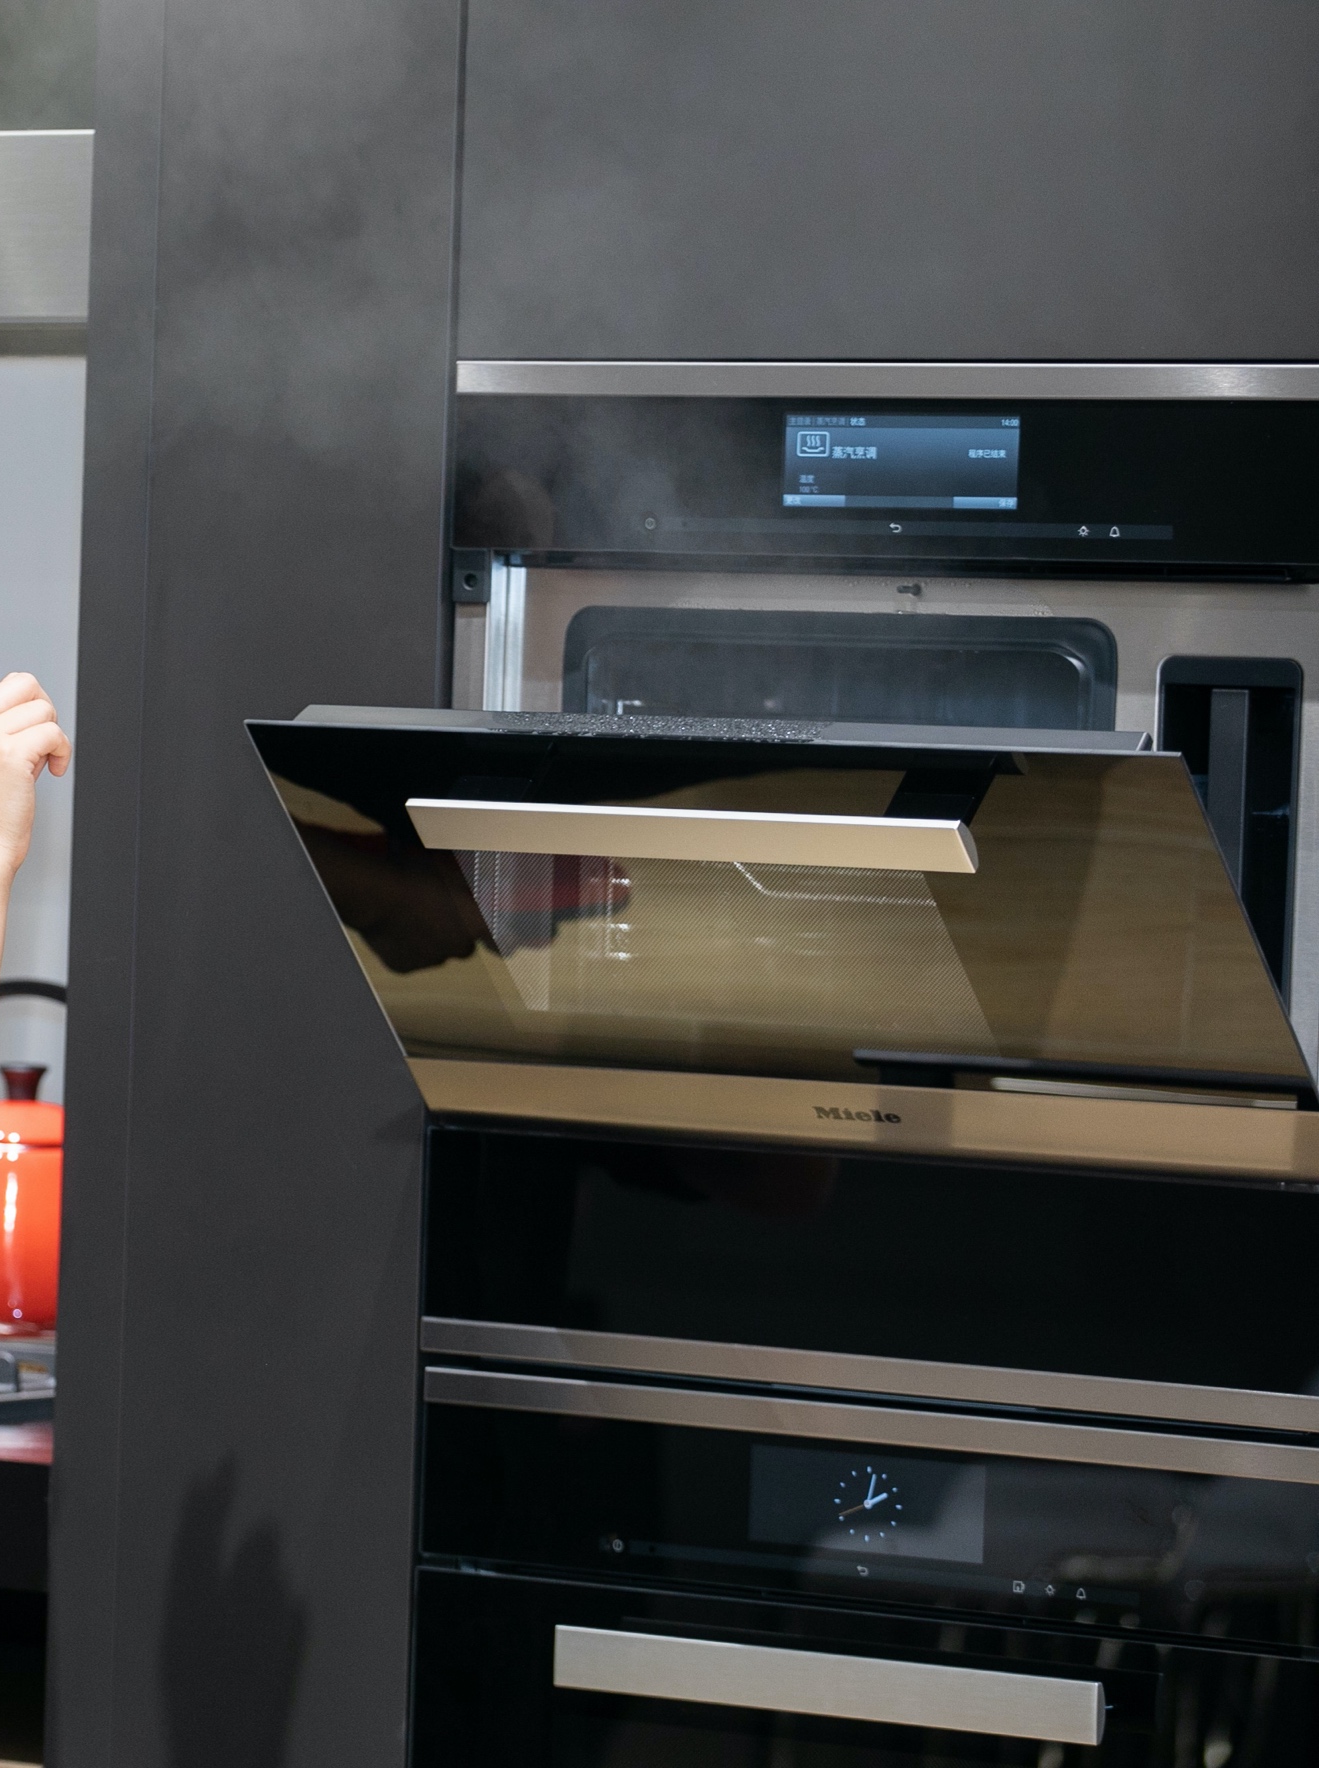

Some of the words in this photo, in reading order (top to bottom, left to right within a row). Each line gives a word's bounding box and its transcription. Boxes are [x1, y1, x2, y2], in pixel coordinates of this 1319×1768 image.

[1002, 419, 1019, 427] 14:00
[832, 446, 877, 459] 蒸汽烹调
[968, 449, 1006, 458] 程序已结束
[812, 1106, 901, 1124] Miele
